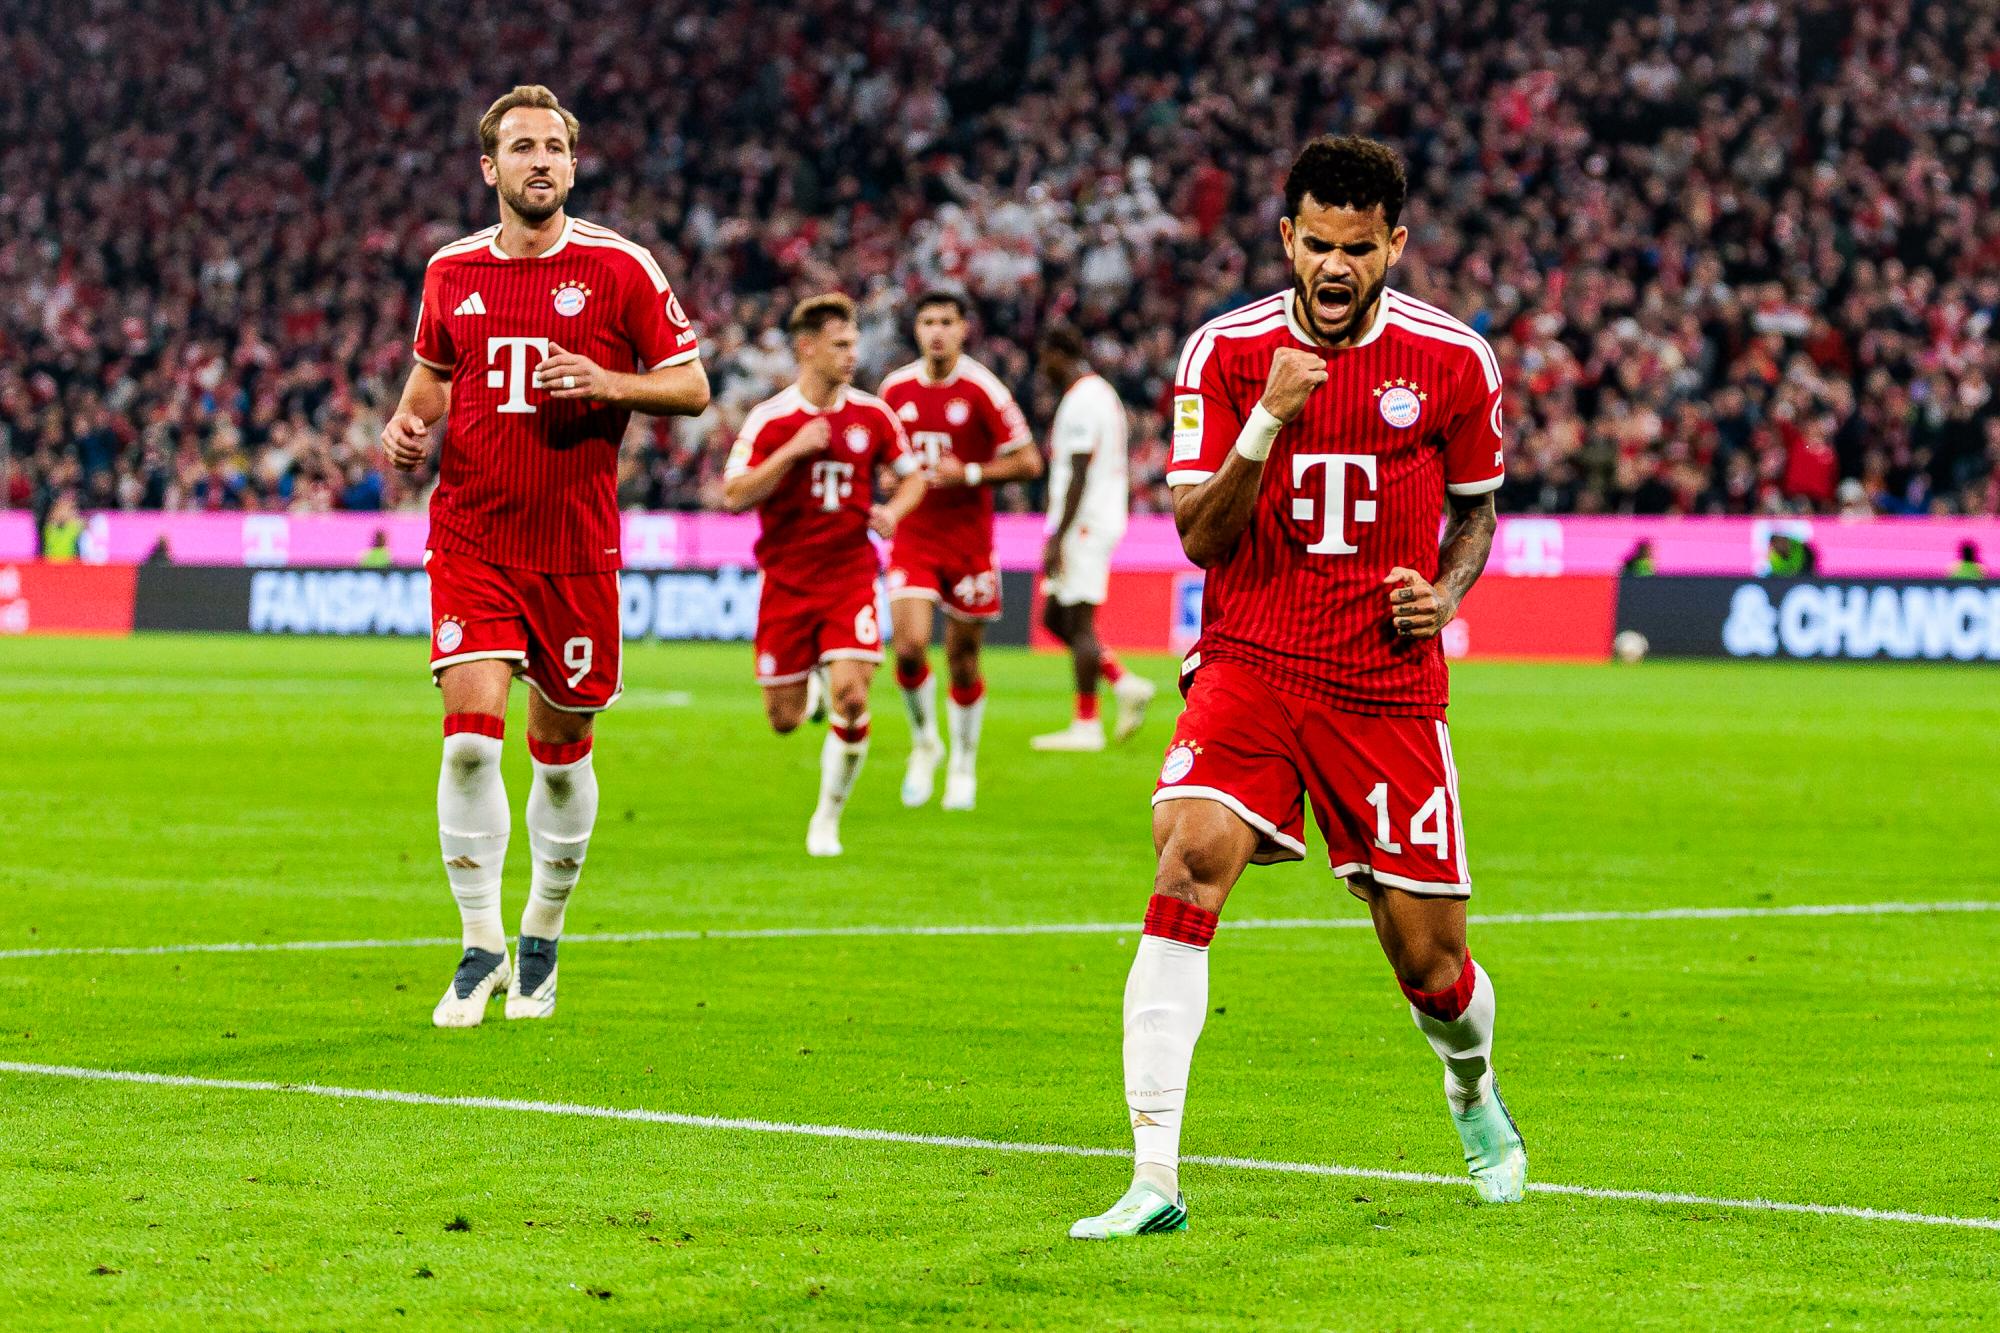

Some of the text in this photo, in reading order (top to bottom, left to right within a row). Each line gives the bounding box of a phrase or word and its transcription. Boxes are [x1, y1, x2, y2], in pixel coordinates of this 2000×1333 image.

[487, 337, 549, 413] T
[811, 461, 854, 512] T
[1293, 454, 1377, 555] T
[855, 604, 877, 645] 6
[1722, 584, 1778, 657] &
[563, 636, 594, 689] 9
[1365, 782, 1448, 861] 14
